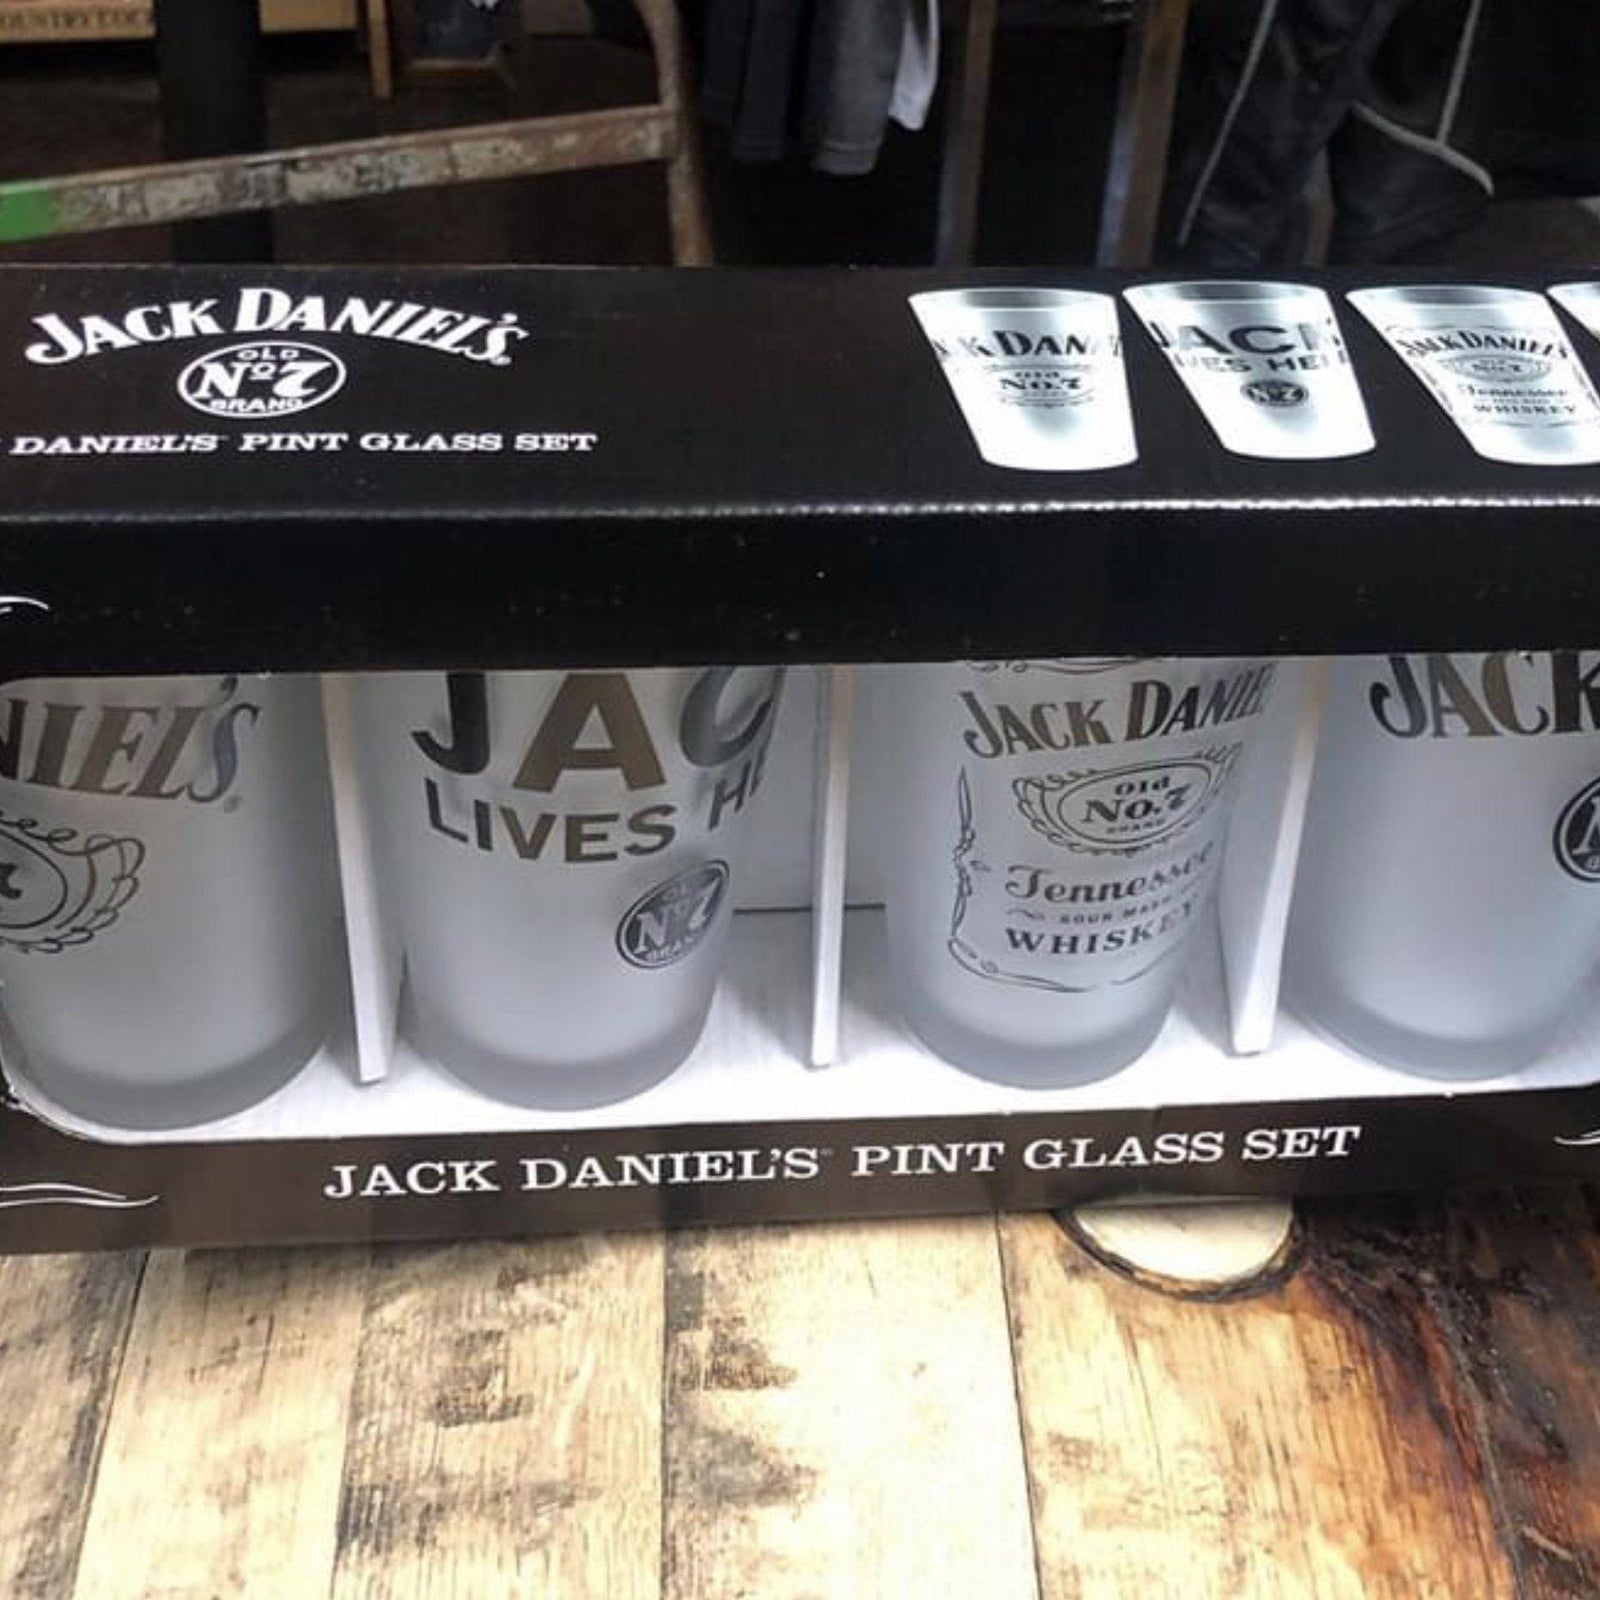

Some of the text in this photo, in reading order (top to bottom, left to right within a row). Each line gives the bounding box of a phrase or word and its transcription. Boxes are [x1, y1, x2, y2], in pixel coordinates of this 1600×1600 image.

[25, 287, 530, 365] JACK DANIEL'S
[237, 347, 299, 360] OLD
[210, 398, 303, 413] BRAND
[8, 432, 598, 455] DANIEL'S PINT GLASS SET
[959, 691, 1112, 760] JACK
[1368, 653, 1600, 738] JACK
[424, 776, 678, 863] LIVES
[1060, 912, 1113, 925] SOUR
[324, 1125, 1361, 1198] JACK DANIEL'S PINT GLASS SET
